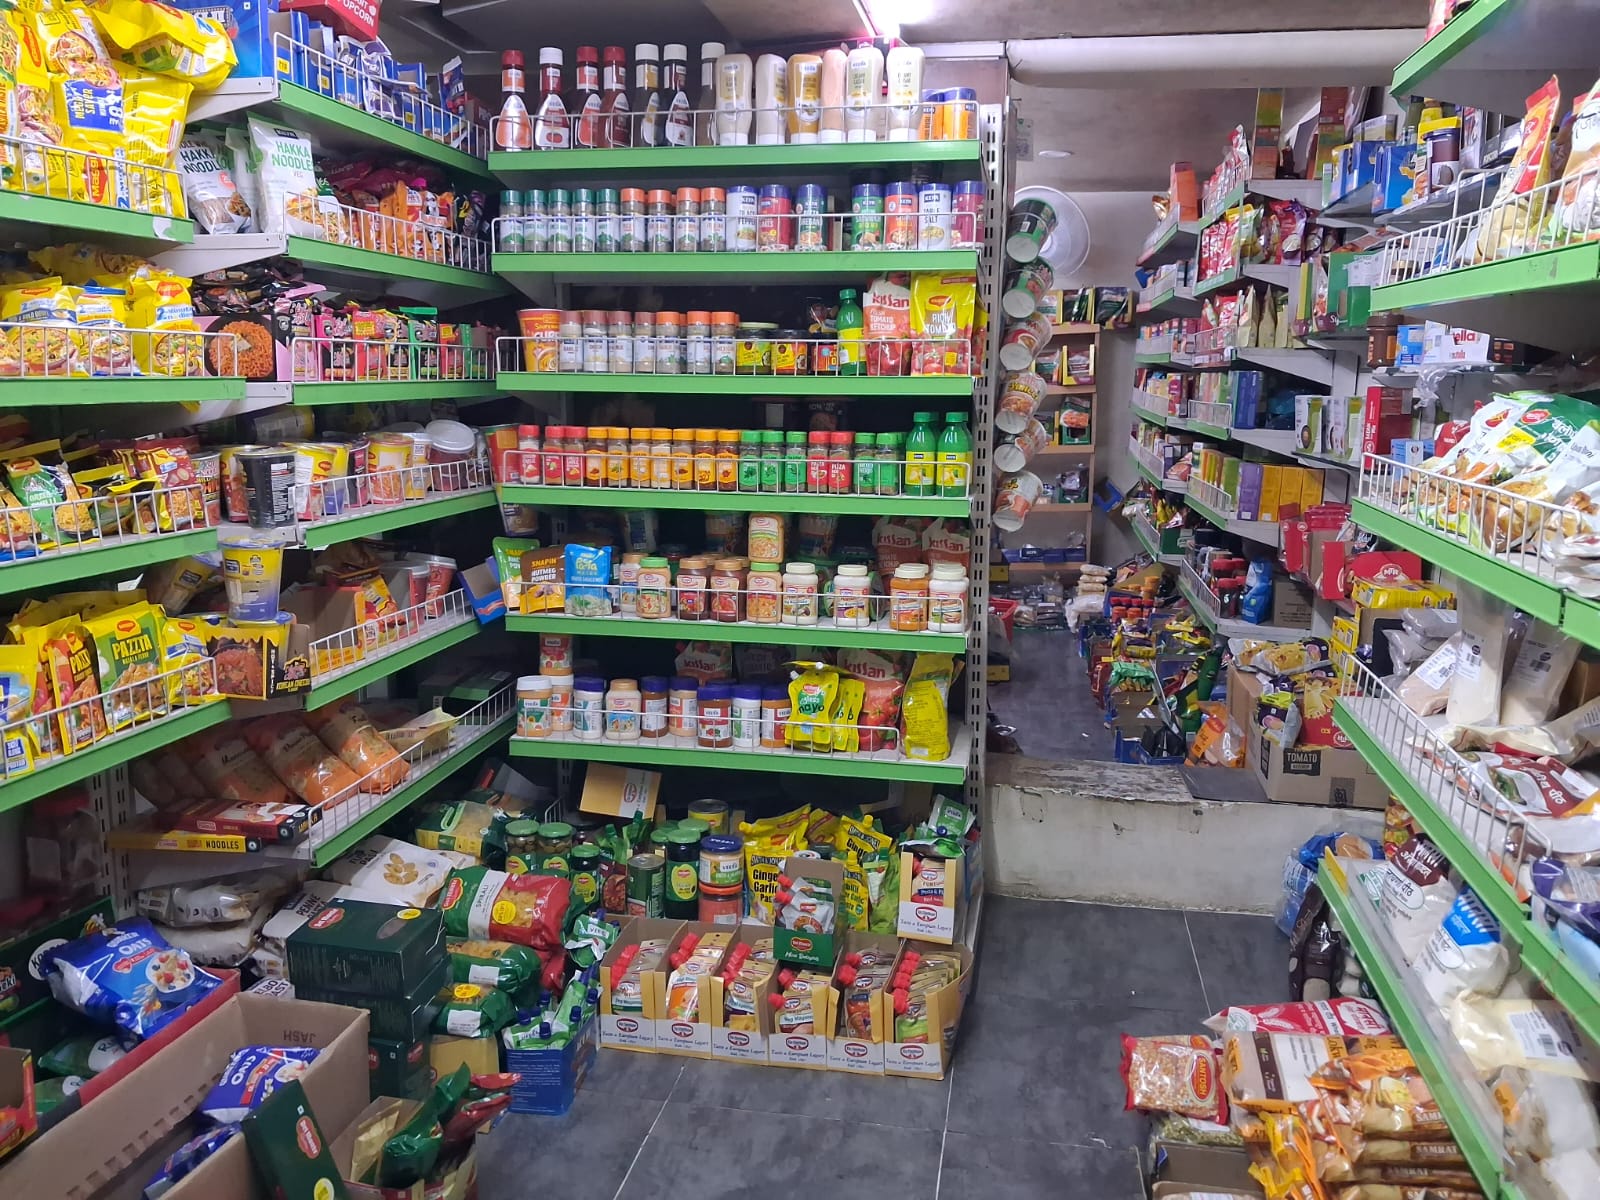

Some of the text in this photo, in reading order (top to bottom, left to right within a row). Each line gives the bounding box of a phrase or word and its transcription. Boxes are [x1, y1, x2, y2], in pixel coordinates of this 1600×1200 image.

[338, 0, 374, 28] OPCORN
[276, 141, 310, 158] HAKKA
[872, 292, 910, 307] kissan
[877, 533, 911, 546] kissan
[929, 537, 964, 552] kissan
[531, 557, 557, 568] SNAPIN
[531, 567, 557, 577] NUTMEG
[531, 574, 557, 583] POWDER
[845, 659, 886, 678] kissan
[1287, 752, 1318, 763] TOMATO
[205, 839, 240, 850] NOODLES
[752, 868, 778, 882] Ginge
[475, 884, 489, 908] SPIRALI
[296, 893, 321, 916] PENNE
[118, 938, 152, 955] OATS
[231, 1055, 256, 1085] OATS
[1199, 1057, 1208, 1096] SANTOSH
[1415, 1145, 1457, 1154] SAMRAT
[1407, 1190, 1449, 1199] SAAT
